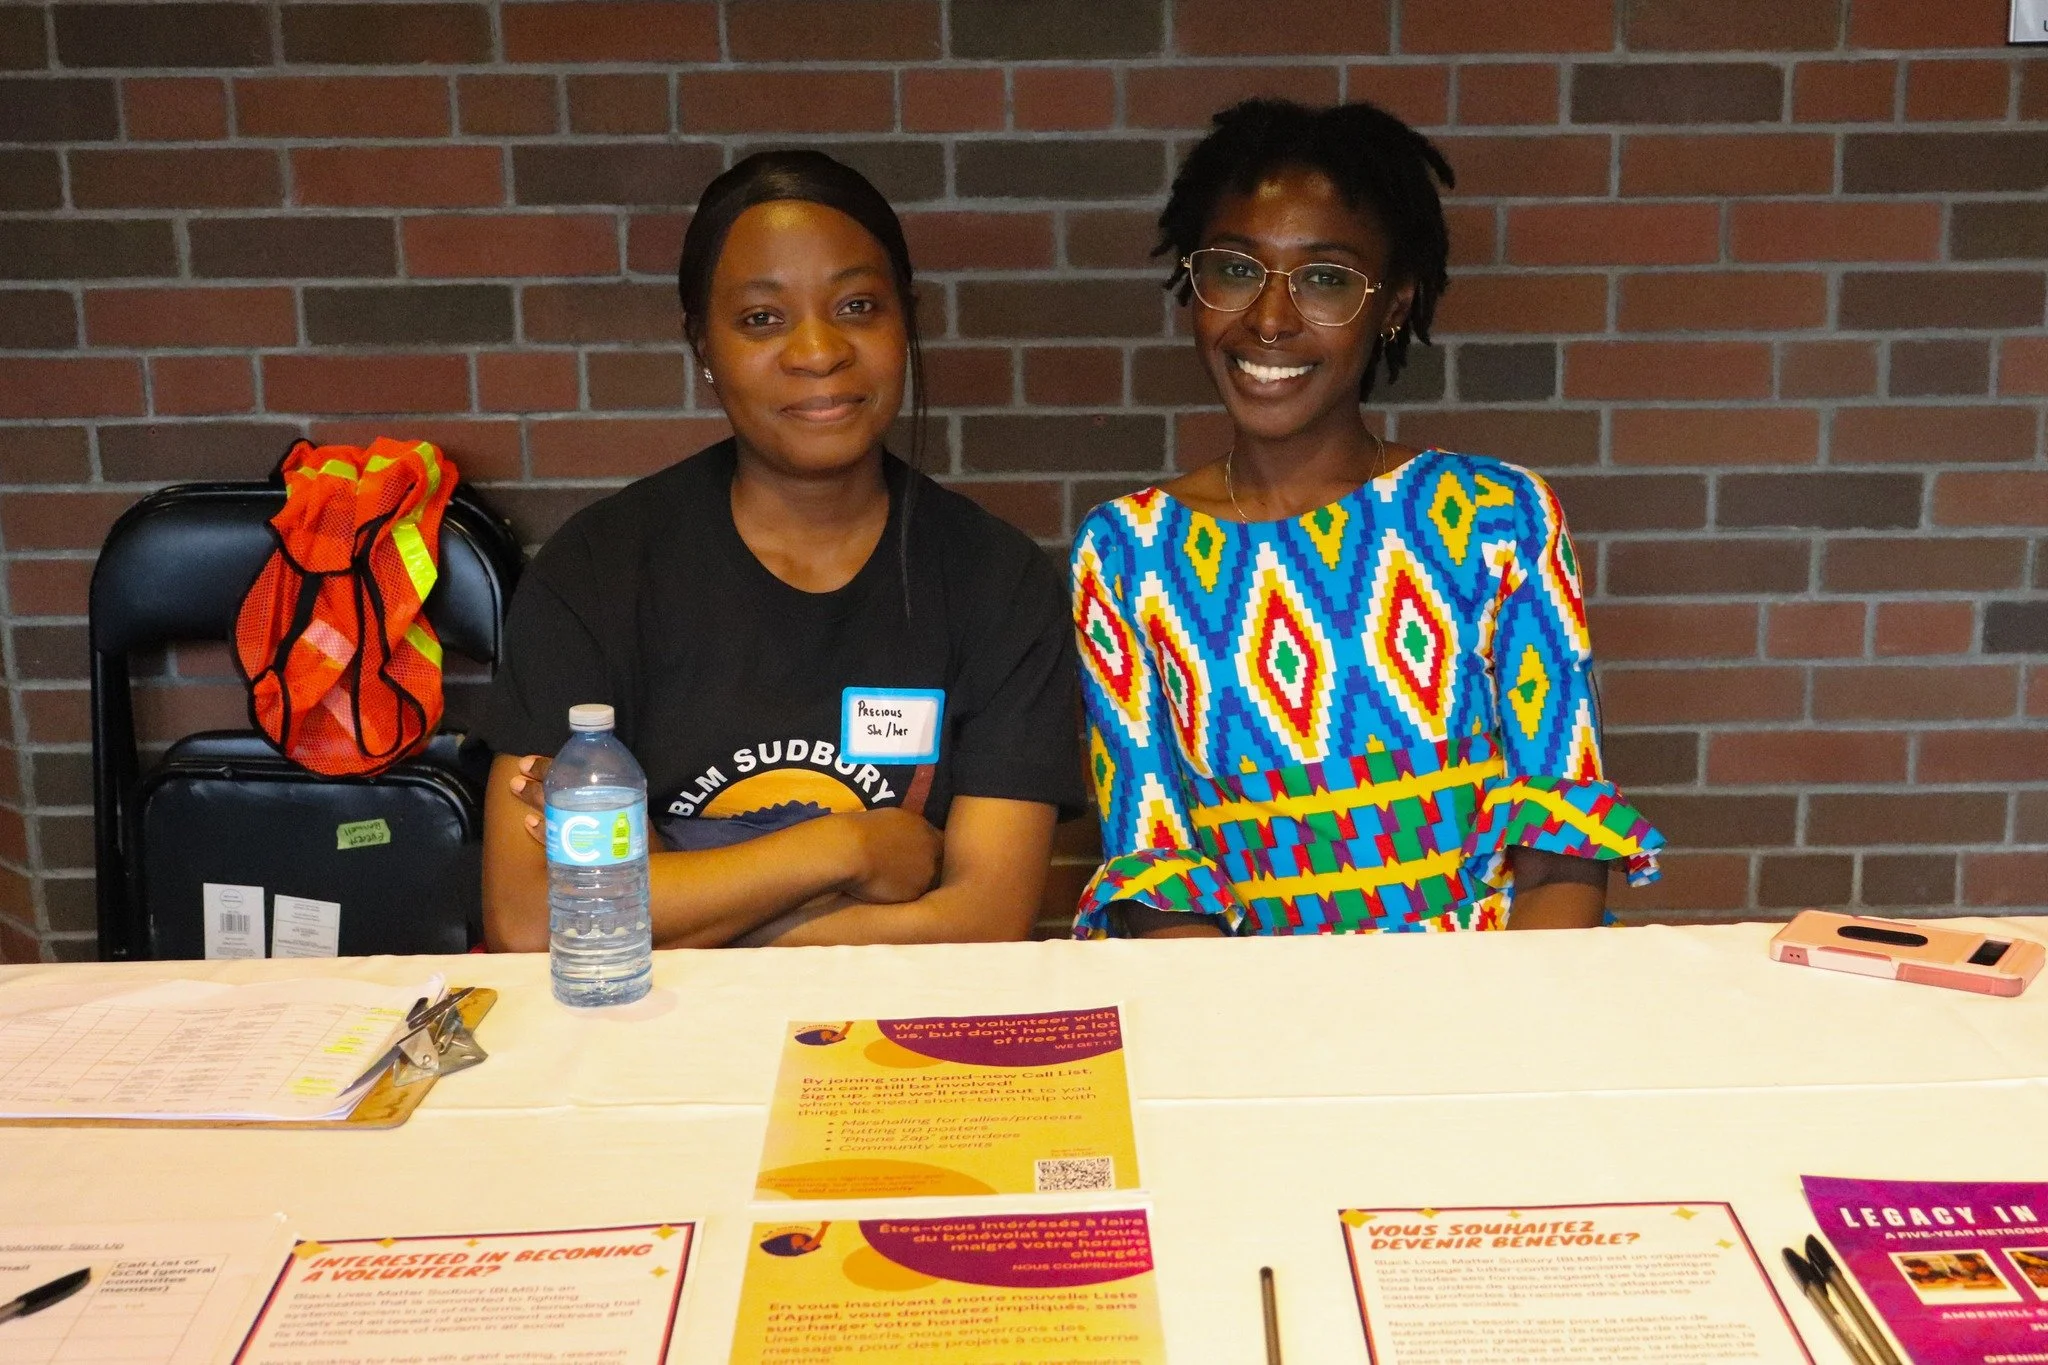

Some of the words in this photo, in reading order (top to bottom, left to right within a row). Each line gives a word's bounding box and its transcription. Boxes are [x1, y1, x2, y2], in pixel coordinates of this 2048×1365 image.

[668, 765, 728, 816] BLM
[893, 1021, 945, 1031] Want
[951, 1021, 970, 1029] to
[976, 1017, 1069, 1029] volunteer
[1074, 1011, 1115, 1021] with
[896, 1032, 922, 1040] us,
[928, 1029, 962, 1038] but
[968, 1027, 1017, 1036] don't
[1023, 1025, 1068, 1034] have
[1076, 1023, 1085, 1031] a
[1092, 1020, 1116, 1029] lot
[993, 1037, 1010, 1045] of
[1018, 1035, 1056, 1043] free
[1063, 1030, 1117, 1040] time?
[803, 1077, 823, 1085] By
[829, 1077, 883, 1085] joining
[922, 1073, 1016, 1082] brand-new
[936, 1080, 1012, 1088] involved!
[800, 1093, 835, 1101] Sign
[910, 1089, 946, 1097] we'll
[798, 1108, 847, 1117] things
[839, 1144, 934, 1152] Community
[1101, 1217, 1143, 1226] faire
[1839, 1206, 1976, 1228] LEGACY
[1993, 1205, 2038, 1223] IN
[1368, 1225, 1439, 1237] VOUS
[1449, 1220, 1596, 1236] SOUHAITEZ
[1885, 1231, 1897, 1240] A
[1899, 1229, 1975, 1239] FIVE-YEAR
[914, 1234, 937, 1242] du
[1044, 1231, 1089, 1239] avec
[1022, 1240, 1073, 1249] votre
[1078, 1238, 1147, 1247] horaire
[1371, 1236, 1483, 1251] DEVENIR
[309, 1251, 469, 1270] INTERESTED
[475, 1250, 510, 1263] IN
[513, 1243, 654, 1263] BECOMING
[302, 1269, 322, 1283] A
[332, 1264, 502, 1282] VOLUNTEER?
[769, 1302, 791, 1310] En
[845, 1298, 936, 1308] inscrivant
[897, 1307, 990, 1317] demeurez
[767, 1322, 867, 1333] surcharger
[875, 1320, 922, 1328] votre
[909, 1329, 952, 1338] nous
